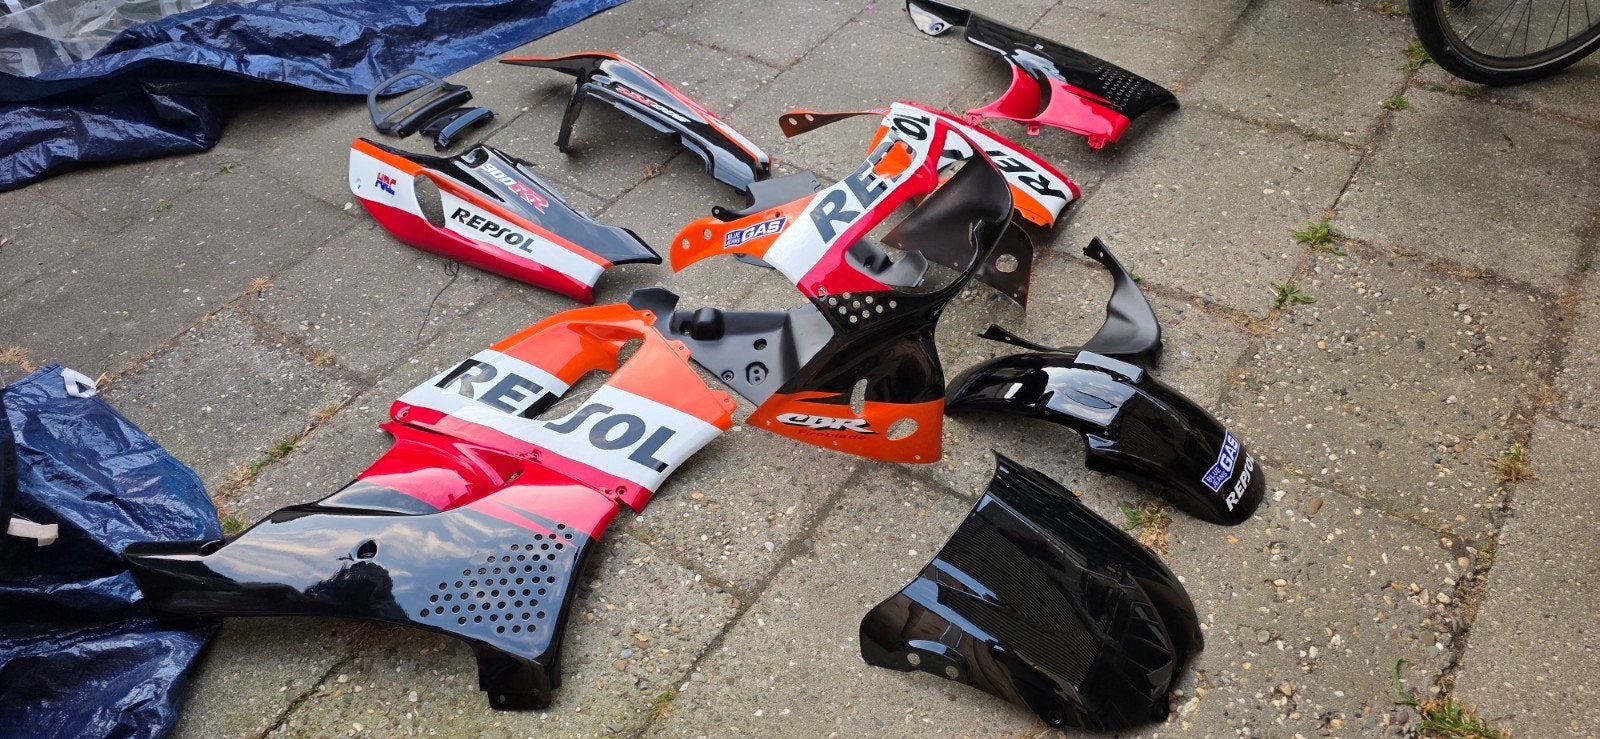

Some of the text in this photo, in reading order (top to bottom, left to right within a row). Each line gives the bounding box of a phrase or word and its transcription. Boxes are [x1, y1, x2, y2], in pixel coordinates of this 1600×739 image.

[375, 172, 397, 195] HRC
[450, 207, 533, 253] REPSOL
[727, 231, 741, 240] BLUE
[741, 220, 780, 241] GAS
[1220, 435, 1239, 473] GAS
[1205, 466, 1222, 484] BLUE
[1212, 470, 1228, 488] JEANS
